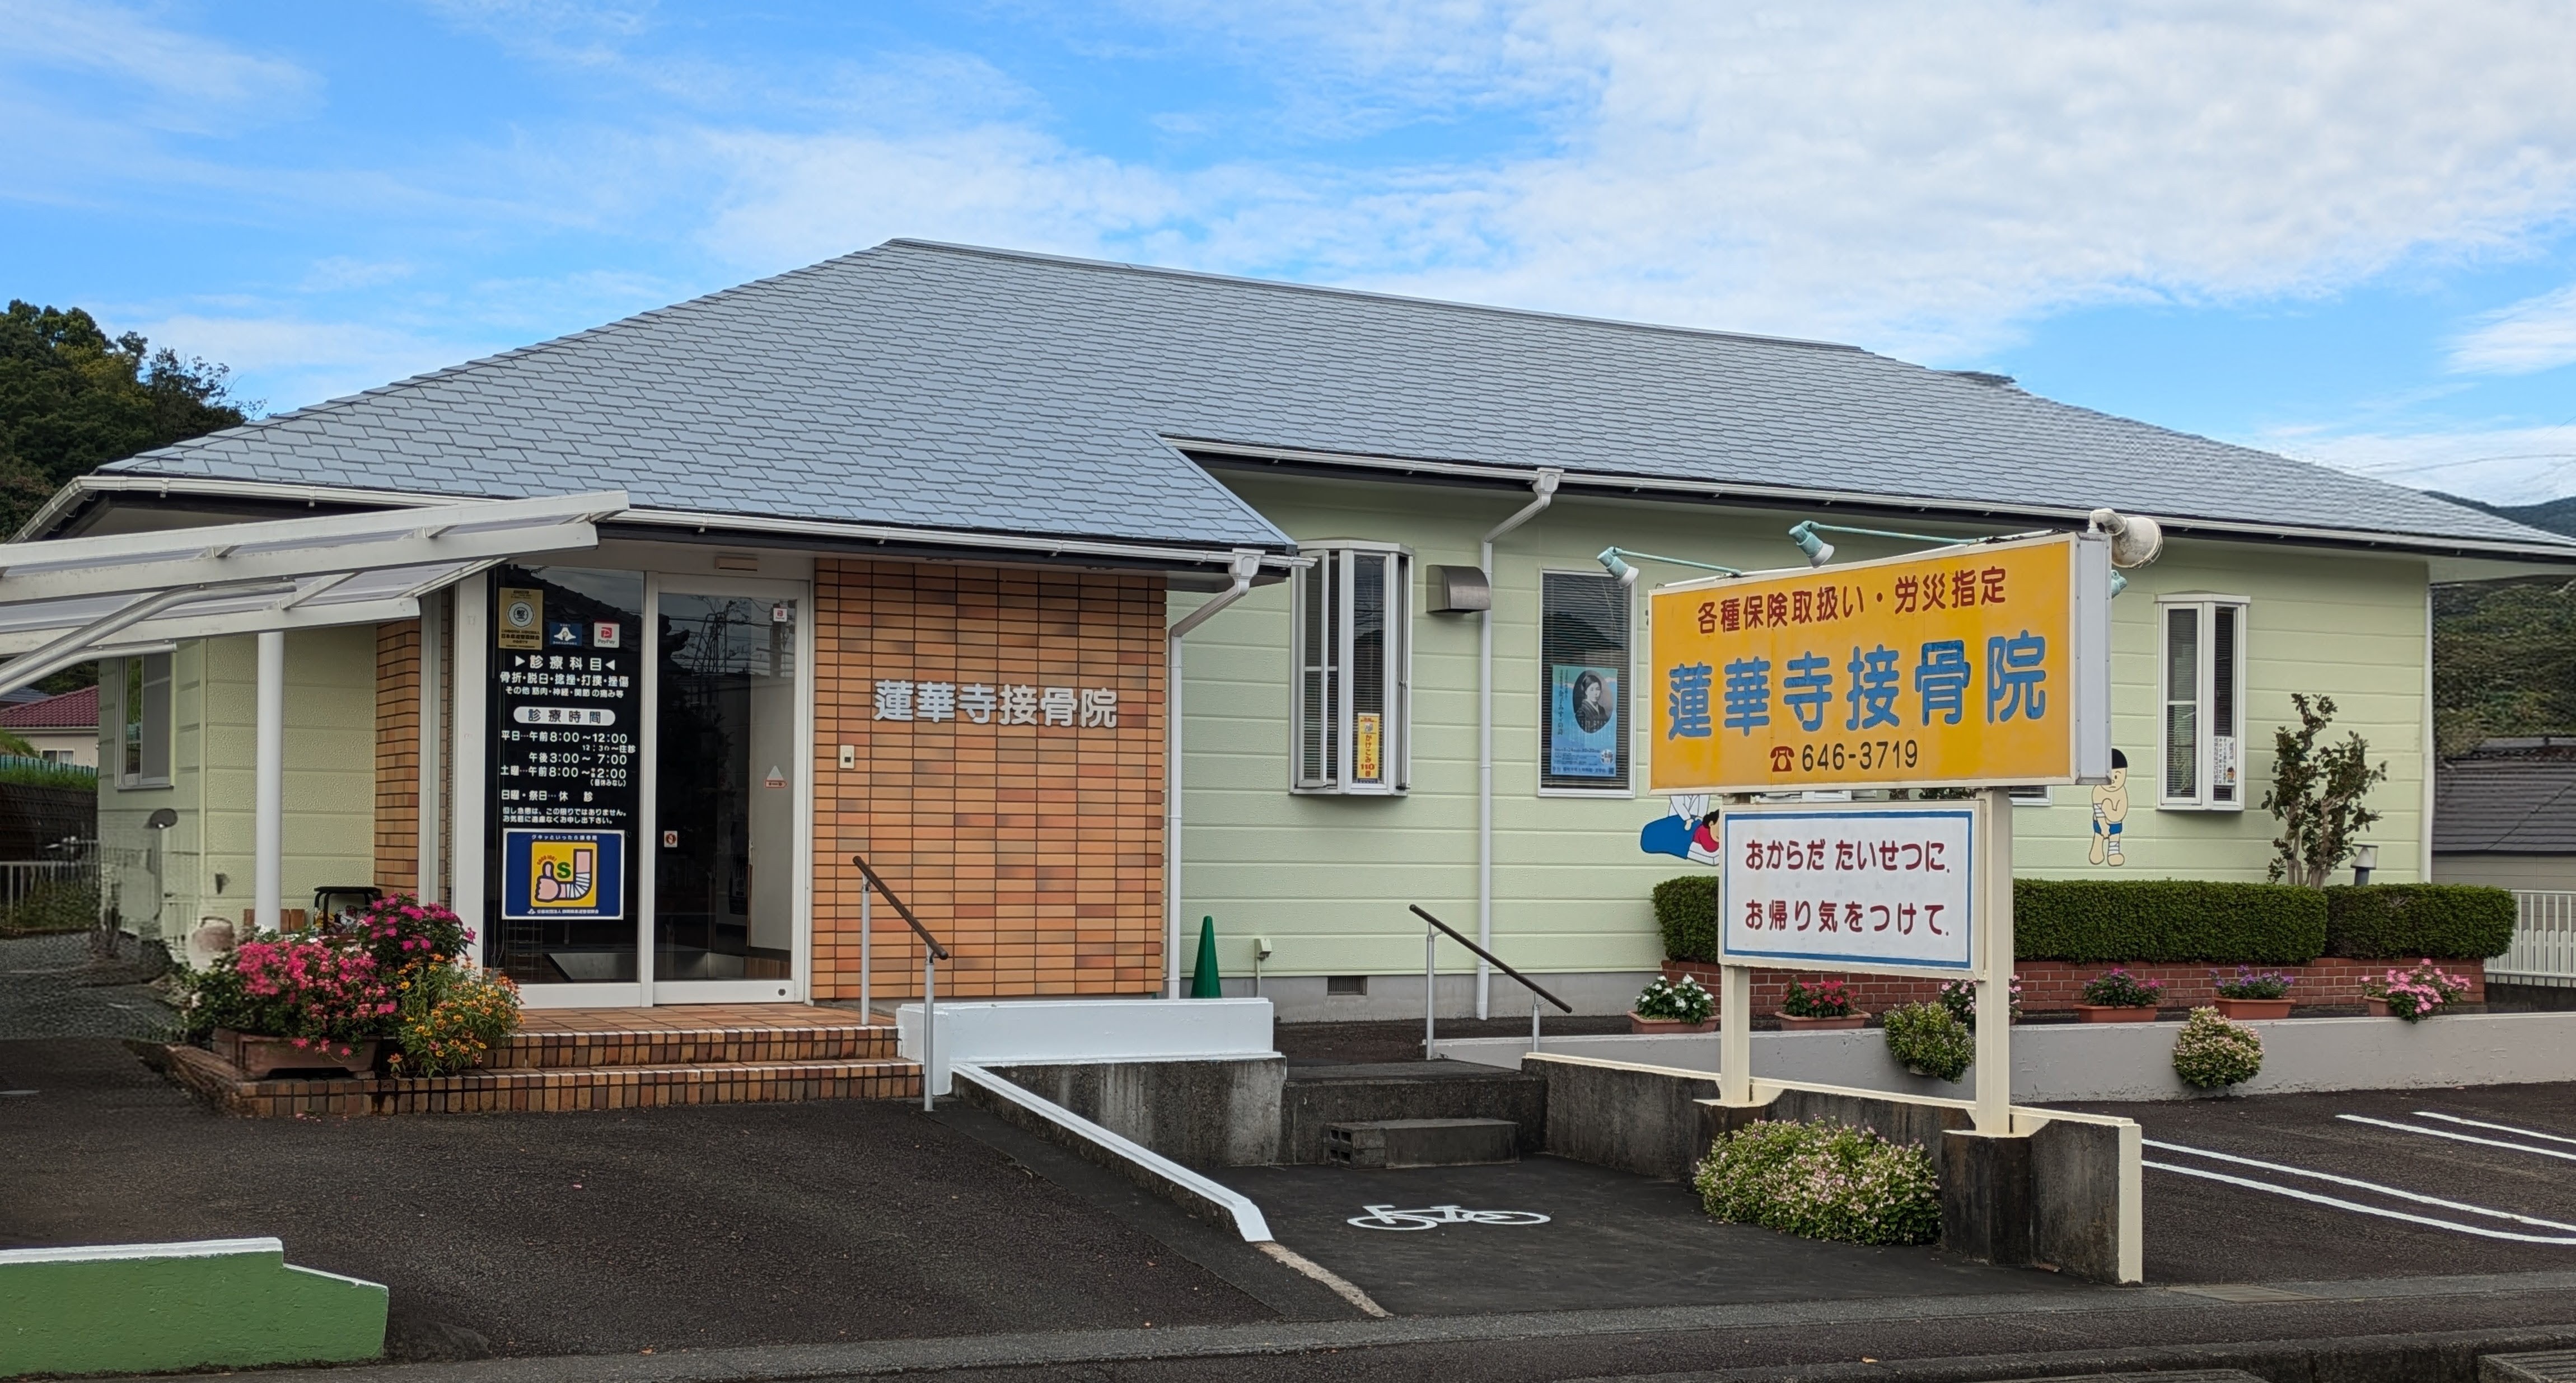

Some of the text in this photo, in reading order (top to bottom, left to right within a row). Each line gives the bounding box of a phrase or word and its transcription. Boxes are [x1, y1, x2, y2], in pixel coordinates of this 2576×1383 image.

[1698, 565, 2007, 633] 各種保険取扱い・労災指定
[530, 655, 601, 671] 診療科目
[1668, 630, 2046, 740] 蓮華寺接骨院
[528, 709, 601, 724] 診療時間
[873, 679, 1117, 728] 蓮華寺接骨院
[1802, 739, 1918, 771] 646-3719
[1745, 838, 1826, 871] おからだ
